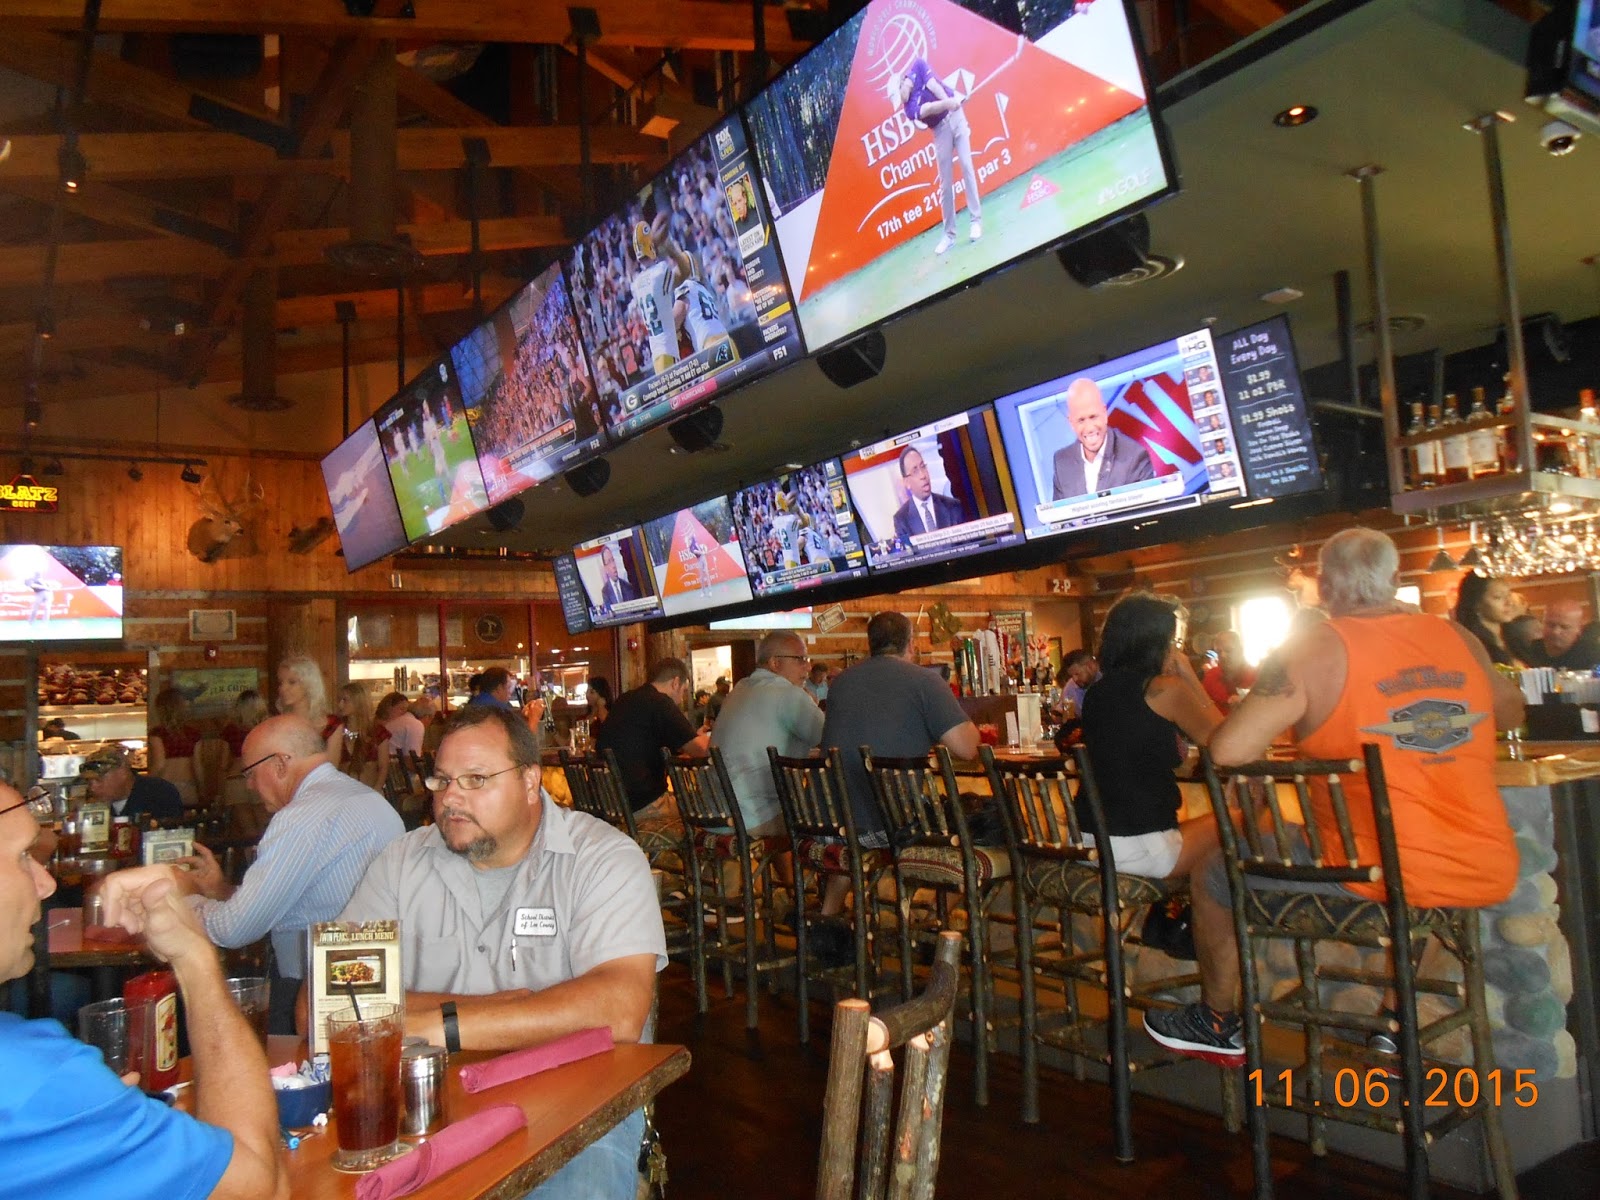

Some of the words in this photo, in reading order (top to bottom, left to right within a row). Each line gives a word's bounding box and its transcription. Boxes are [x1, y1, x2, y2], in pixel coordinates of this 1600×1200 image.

[715, 126, 731, 145] FOX
[880, 142, 938, 189] Champ
[877, 215, 902, 239] 17th
[903, 205, 922, 223] tee
[977, 161, 999, 183] par
[1001, 148, 1012, 166] 3
[1233, 338, 1250, 350] ALL
[1251, 332, 1269, 345] Day
[772, 345, 788, 361] FS1
[1230, 350, 1258, 364] Every
[1258, 344, 1277, 356] Day
[1266, 403, 1296, 420] Shots
[521, 921, 527, 929] of
[351, 932, 373, 941] LUNCH
[375, 931, 394, 940] MENU
